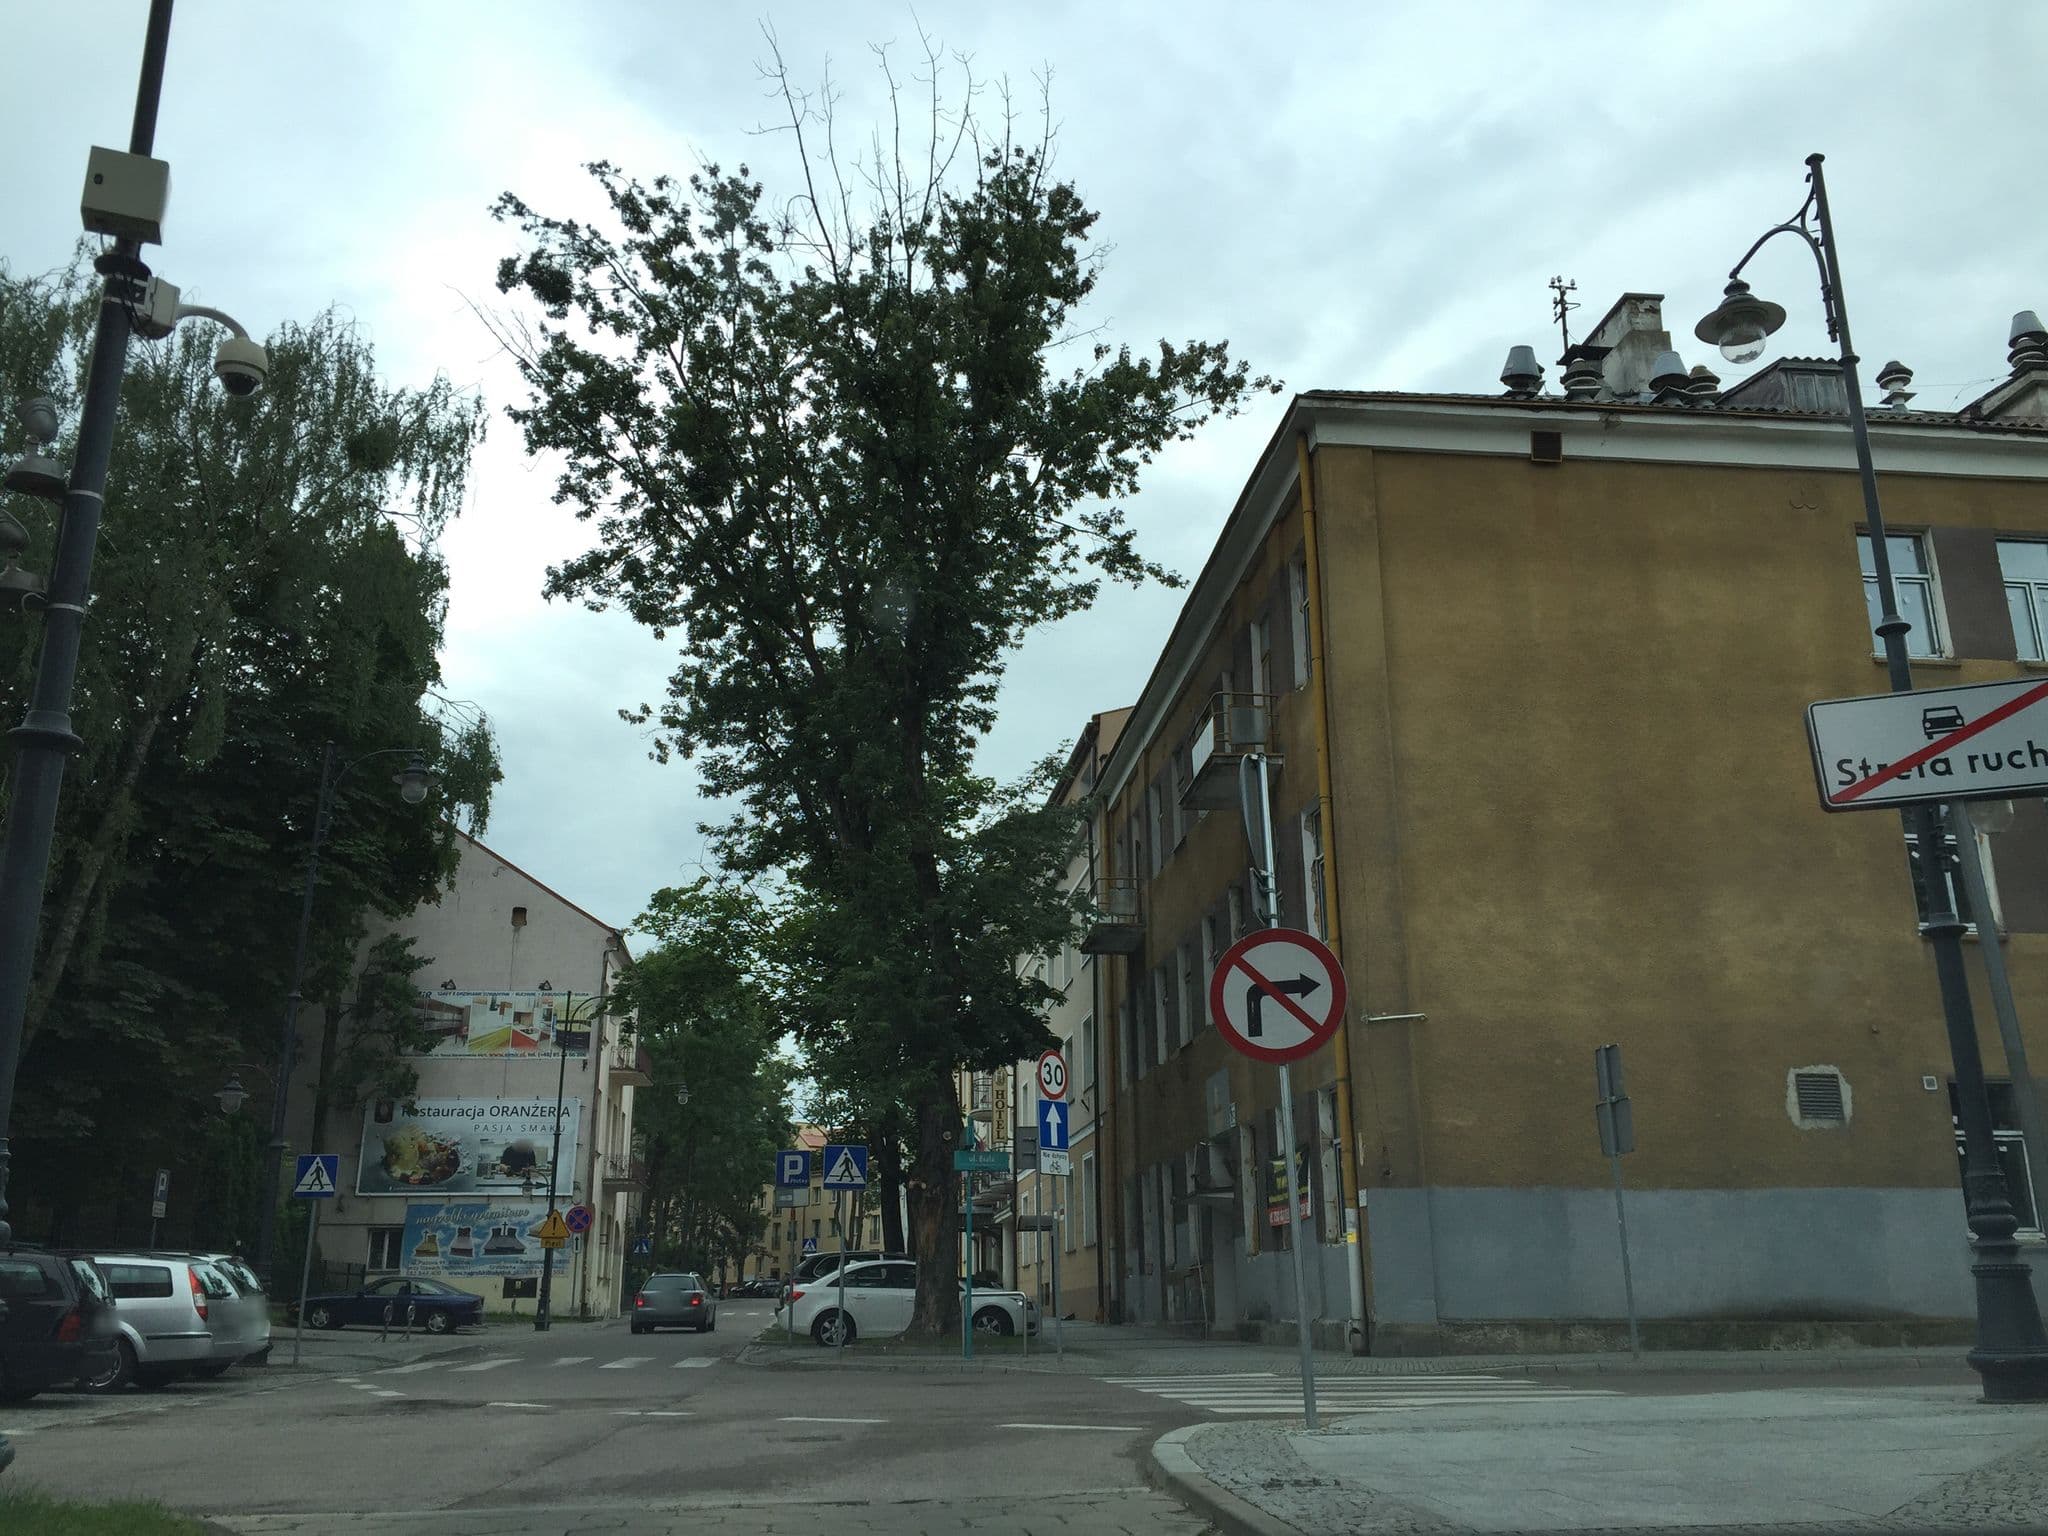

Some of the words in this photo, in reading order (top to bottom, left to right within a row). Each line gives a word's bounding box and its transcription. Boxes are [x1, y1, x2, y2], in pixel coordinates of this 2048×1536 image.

[1043, 1063, 1063, 1086] 30
[489, 1103, 570, 1117] ORANŻERA
[995, 1090, 1006, 1140] HOTEL
[473, 1124, 513, 1133] PASJA
[784, 1155, 803, 1184] P
